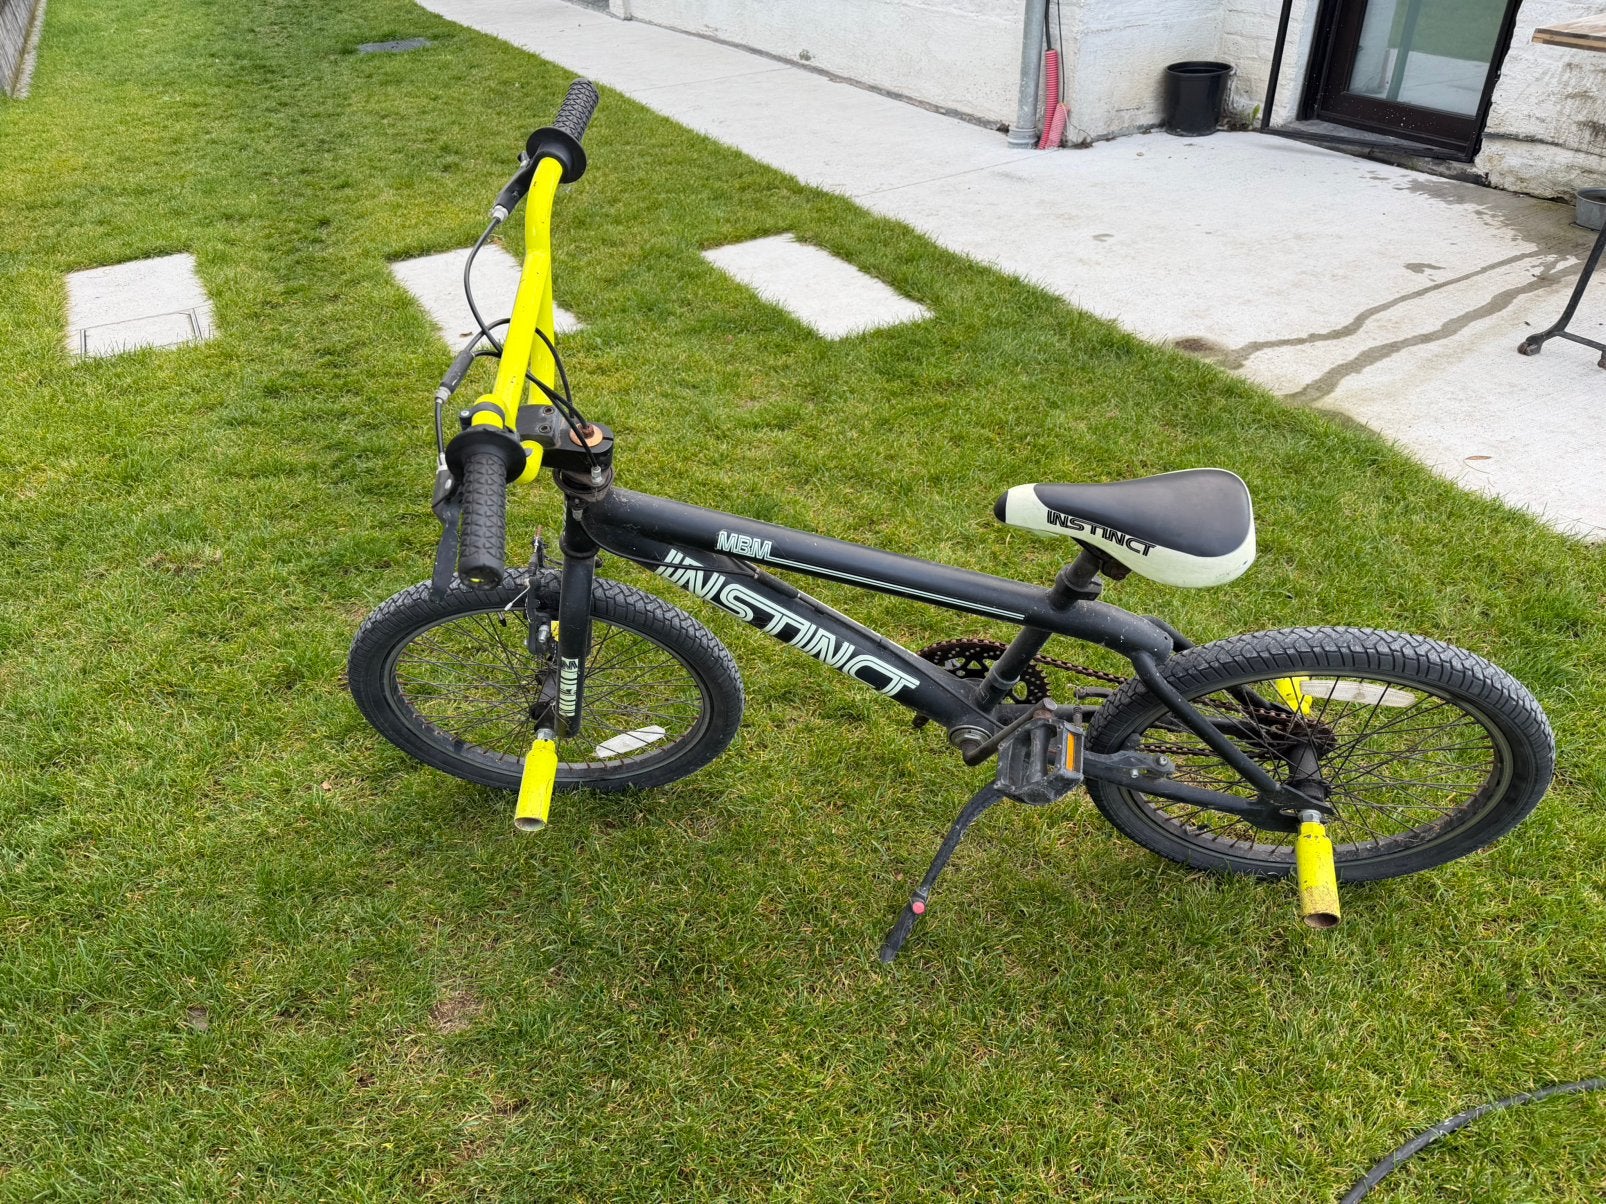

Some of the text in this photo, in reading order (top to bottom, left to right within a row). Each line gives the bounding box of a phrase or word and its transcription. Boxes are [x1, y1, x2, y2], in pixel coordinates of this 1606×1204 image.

[715, 530, 773, 560] MBM
[1047, 509, 1156, 557] INSTINCT
[655, 548, 920, 697] INSTINCT
